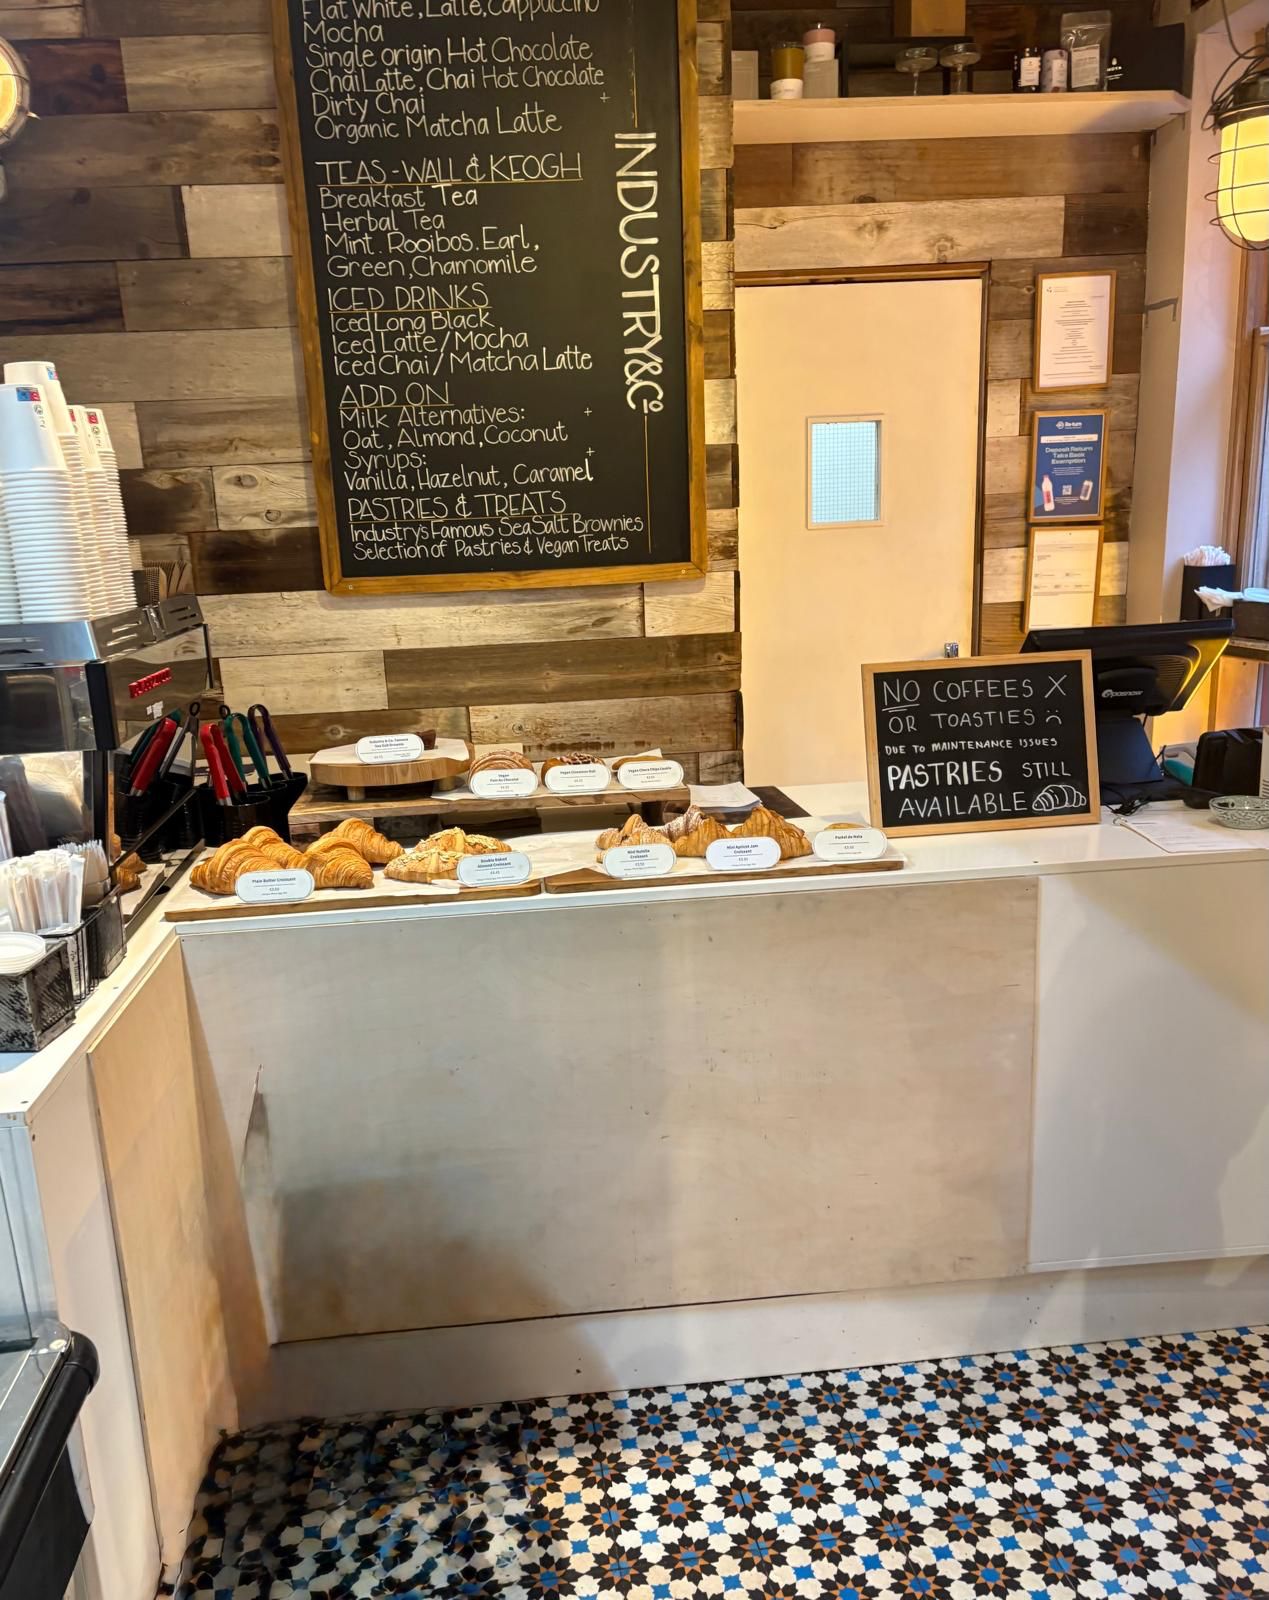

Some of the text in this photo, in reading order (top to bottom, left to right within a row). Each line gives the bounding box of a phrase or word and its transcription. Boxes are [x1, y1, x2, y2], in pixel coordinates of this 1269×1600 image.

[304, 21, 384, 43] Mocha
[306, 32, 592, 71] Single origin Hot Chocolate
[427, 68, 474, 90] Chai
[482, 66, 518, 88] Hot
[523, 62, 604, 87] Chocolate
[312, 92, 425, 122] Dirty Chai
[315, 102, 561, 144] Organic Matcha Latte
[316, 160, 386, 184] TEAS
[402, 158, 461, 183] WALL
[491, 153, 581, 179] KEOGH
[320, 184, 477, 209] Breakfast Tea
[322, 209, 444, 231] Herbal Tea
[412, 252, 537, 276] Chamomile
[328, 282, 489, 311] ICED DRINKS
[330, 308, 494, 334] Iced Long Black
[333, 331, 376, 354] Iced
[334, 355, 376, 376] Iced
[543, 345, 592, 370] Latte
[340, 382, 449, 407] ADD ON
[340, 404, 524, 428] Milk Alternatives:
[343, 430, 392, 450] Oat,
[484, 421, 568, 444] Coconut
[344, 452, 428, 474] Syrups:
[344, 458, 593, 491] Vanilla, Hazelnut, Caramel
[348, 497, 449, 521] PASTRIES
[474, 491, 566, 516] TREATS
[431, 520, 494, 540] Famous
[499, 517, 531, 538] Sea
[532, 514, 569, 534] Salt
[573, 514, 643, 533] Brownies
[352, 541, 428, 560] Selection
[431, 540, 447, 557] of
[455, 539, 521, 556] Pastries
[537, 537, 579, 557] Vegan
[580, 534, 628, 552] Treats
[884, 679, 920, 706] NO
[934, 679, 1033, 702] COFFEES
[889, 709, 1034, 733] OR TOASTIES
[885, 738, 1057, 755] DUE TO MAINTENANCE ISSUES
[888, 761, 1071, 791] PASTRIES STILL
[899, 792, 1027, 819] AVAILABLE
